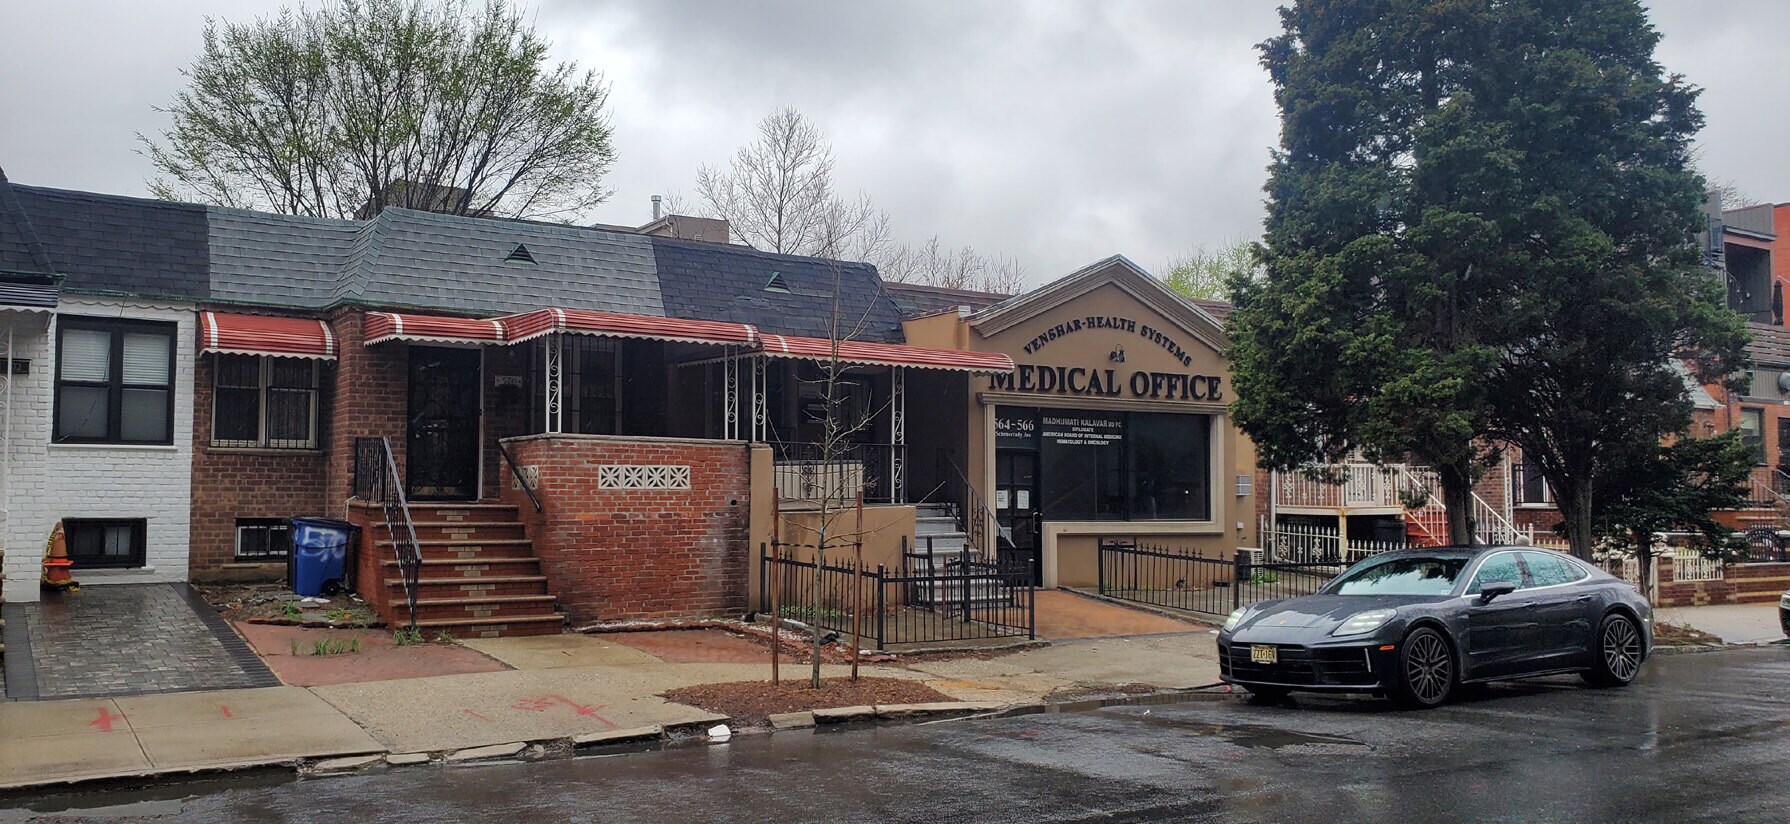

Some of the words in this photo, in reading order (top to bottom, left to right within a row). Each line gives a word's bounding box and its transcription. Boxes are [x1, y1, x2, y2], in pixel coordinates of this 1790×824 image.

[1023, 316, 1136, 354] VENSHAR-HEALTH
[1141, 325, 1193, 367] SYSTEMS
[989, 365, 1122, 397] MEDICAL
[1130, 371, 1223, 401] OFFICE
[1042, 417, 1080, 427] MADHUMATI
[1080, 419, 1108, 428] KALAVAR
